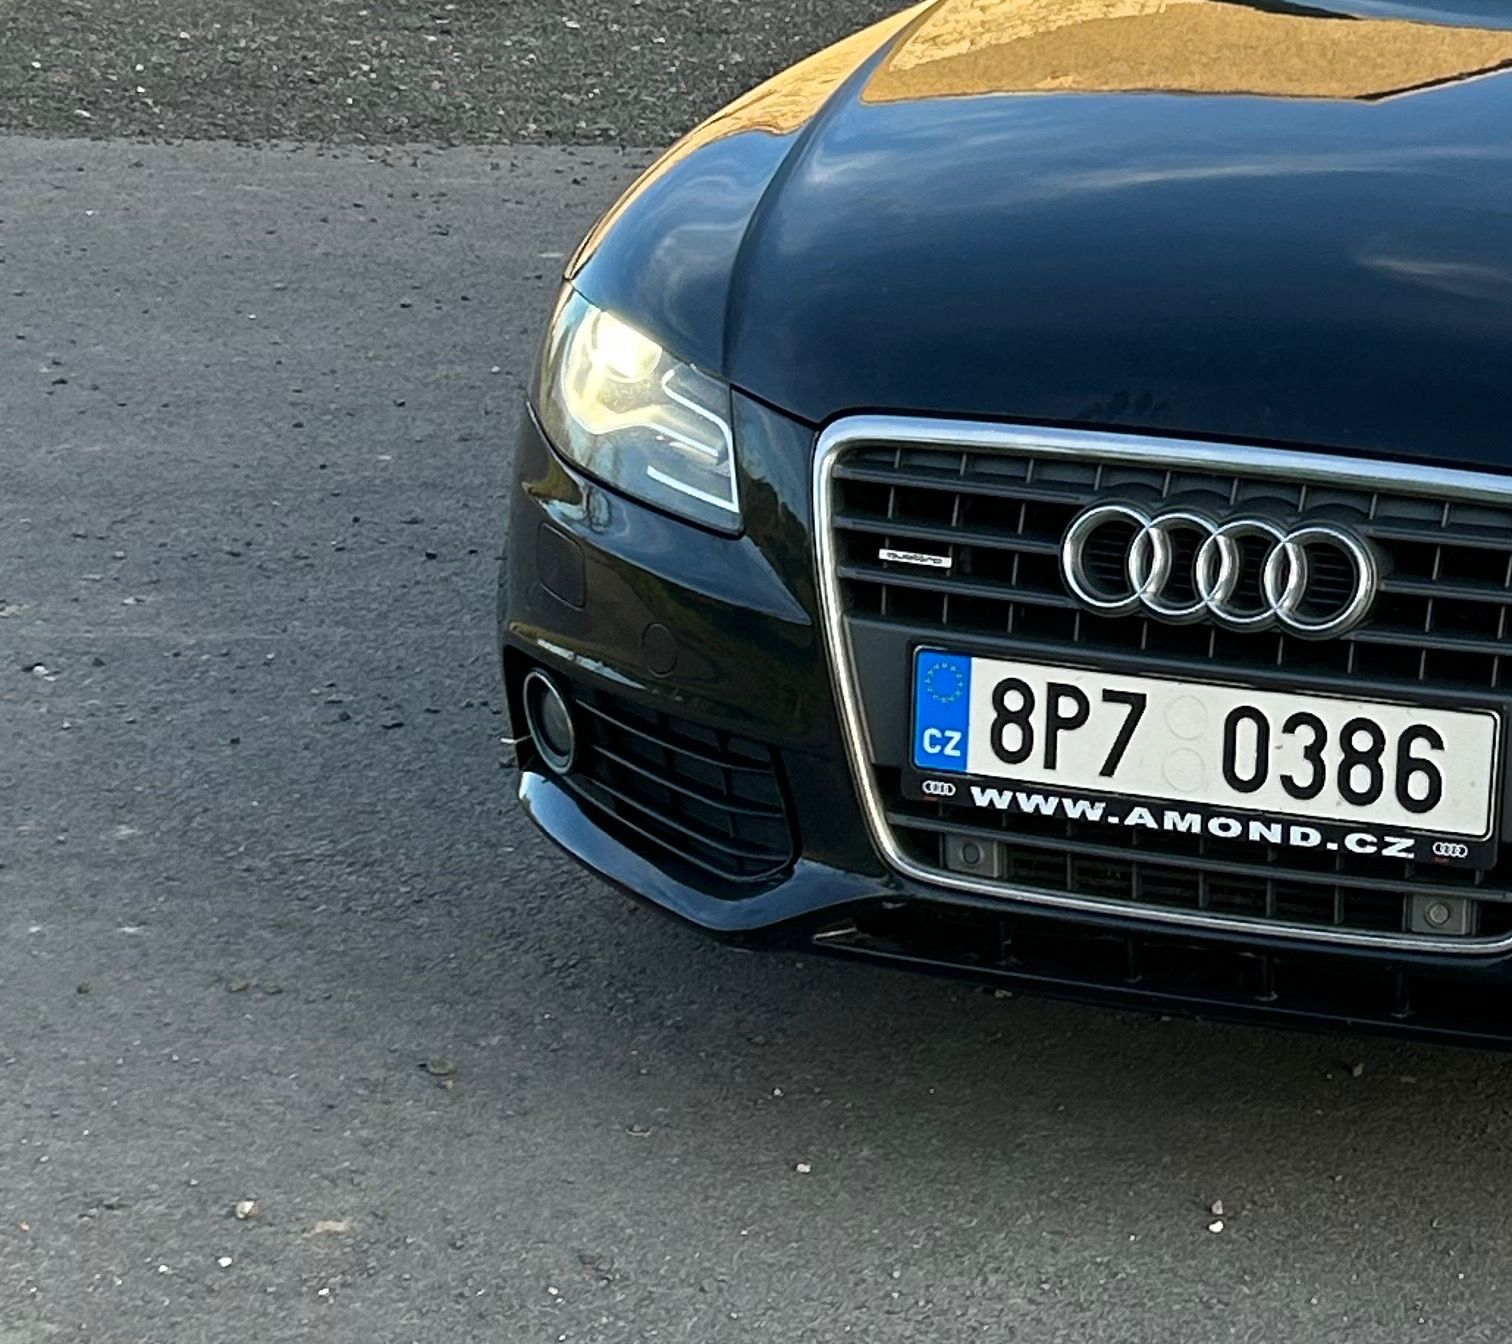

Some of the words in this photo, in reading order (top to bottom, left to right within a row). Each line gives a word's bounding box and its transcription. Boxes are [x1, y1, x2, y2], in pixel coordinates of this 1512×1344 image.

[923, 729, 961, 757] CZ
[990, 677, 1147, 778] 8P7
[1222, 705, 1445, 814] 0386
[969, 785, 1415, 859] WWW.AMOND.CZ
